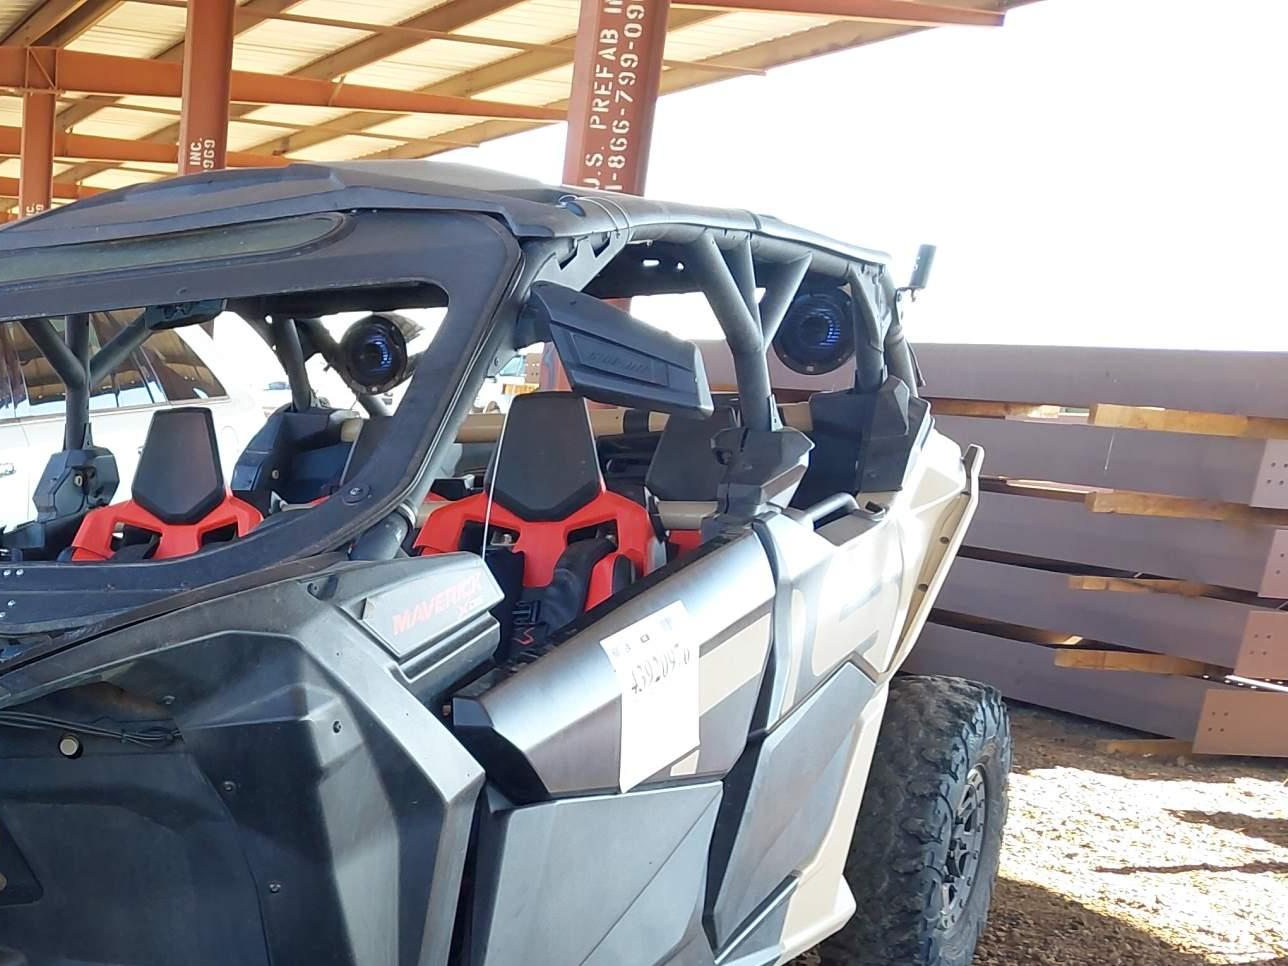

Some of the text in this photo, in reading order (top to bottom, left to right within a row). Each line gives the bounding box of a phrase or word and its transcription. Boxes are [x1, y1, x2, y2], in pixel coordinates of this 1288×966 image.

[589, 28, 619, 130] PREFAB
[604, 0, 645, 191] 1-866-799-09
[189, 137, 203, 166] INC.
[391, 573, 484, 636] MAVERICK
